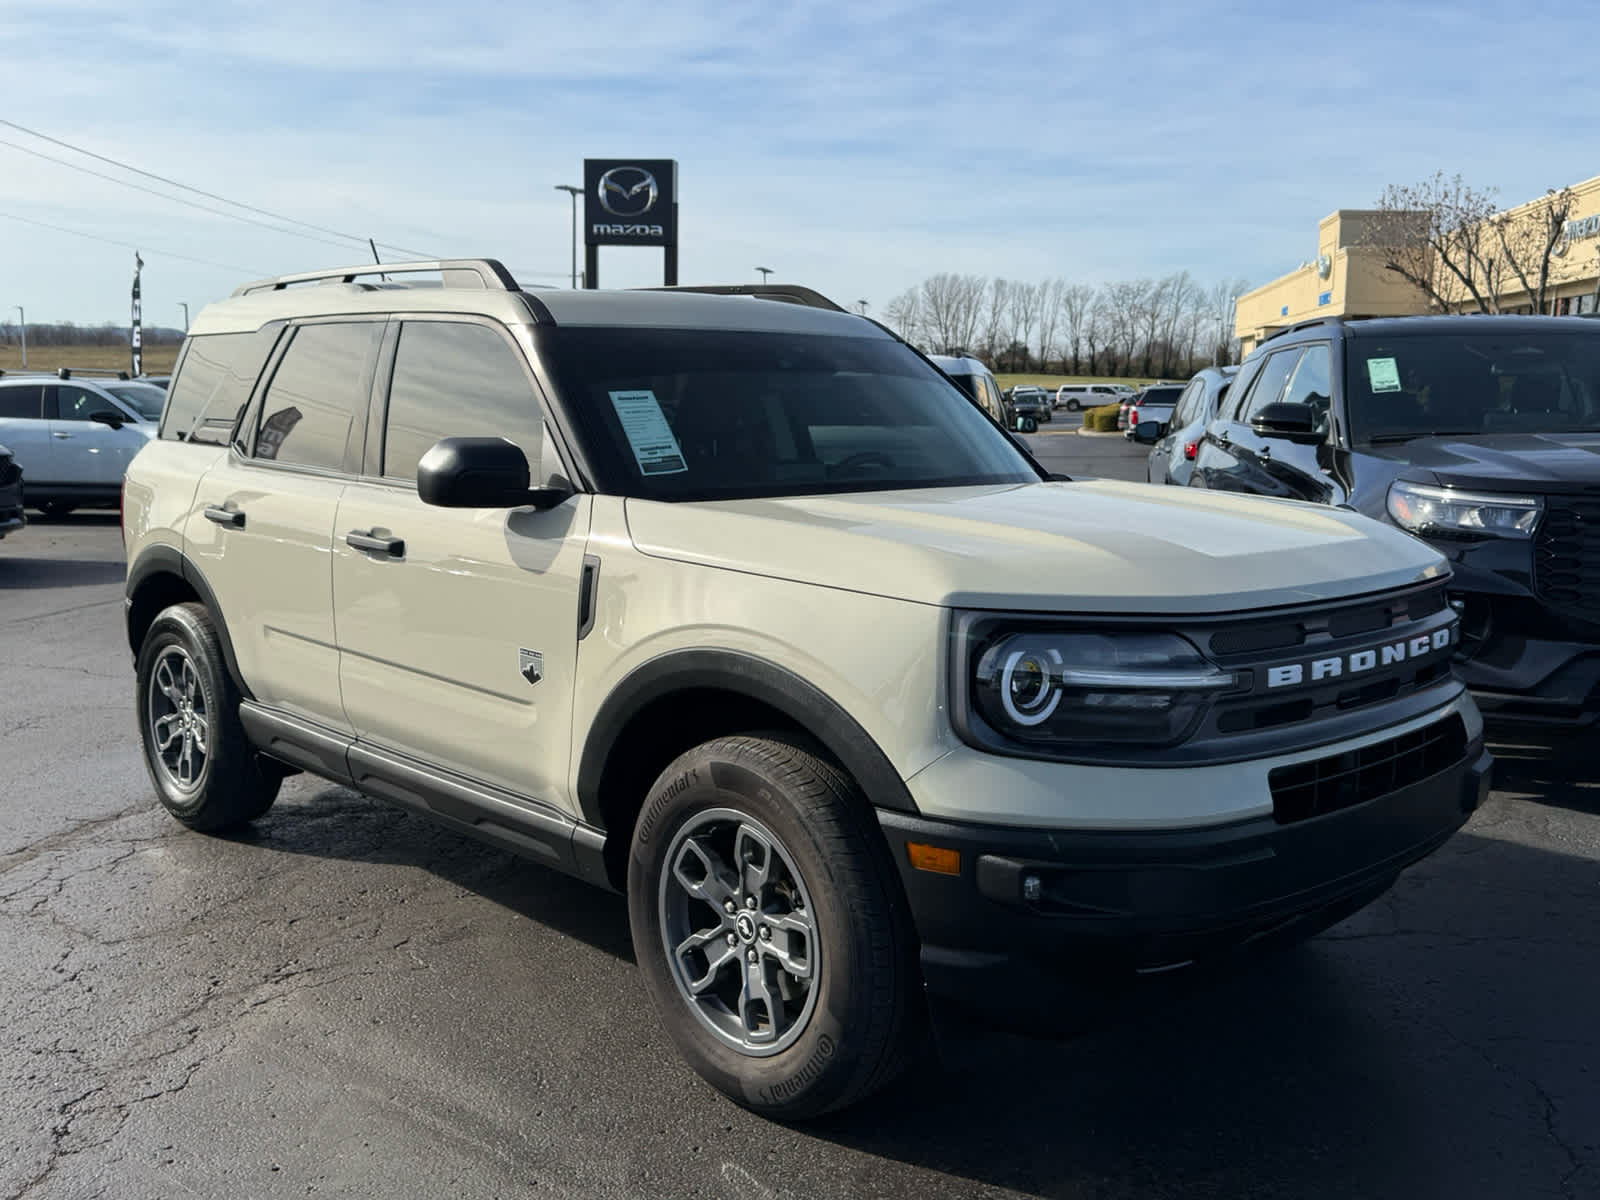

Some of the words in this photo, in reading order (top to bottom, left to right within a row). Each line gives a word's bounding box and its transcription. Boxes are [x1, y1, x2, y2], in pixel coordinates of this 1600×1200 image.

[593, 223, 664, 236] mazda
[1267, 628, 1450, 689] BRONCO
[638, 770, 691, 845] Continental
[768, 1033, 836, 1103] Continental
